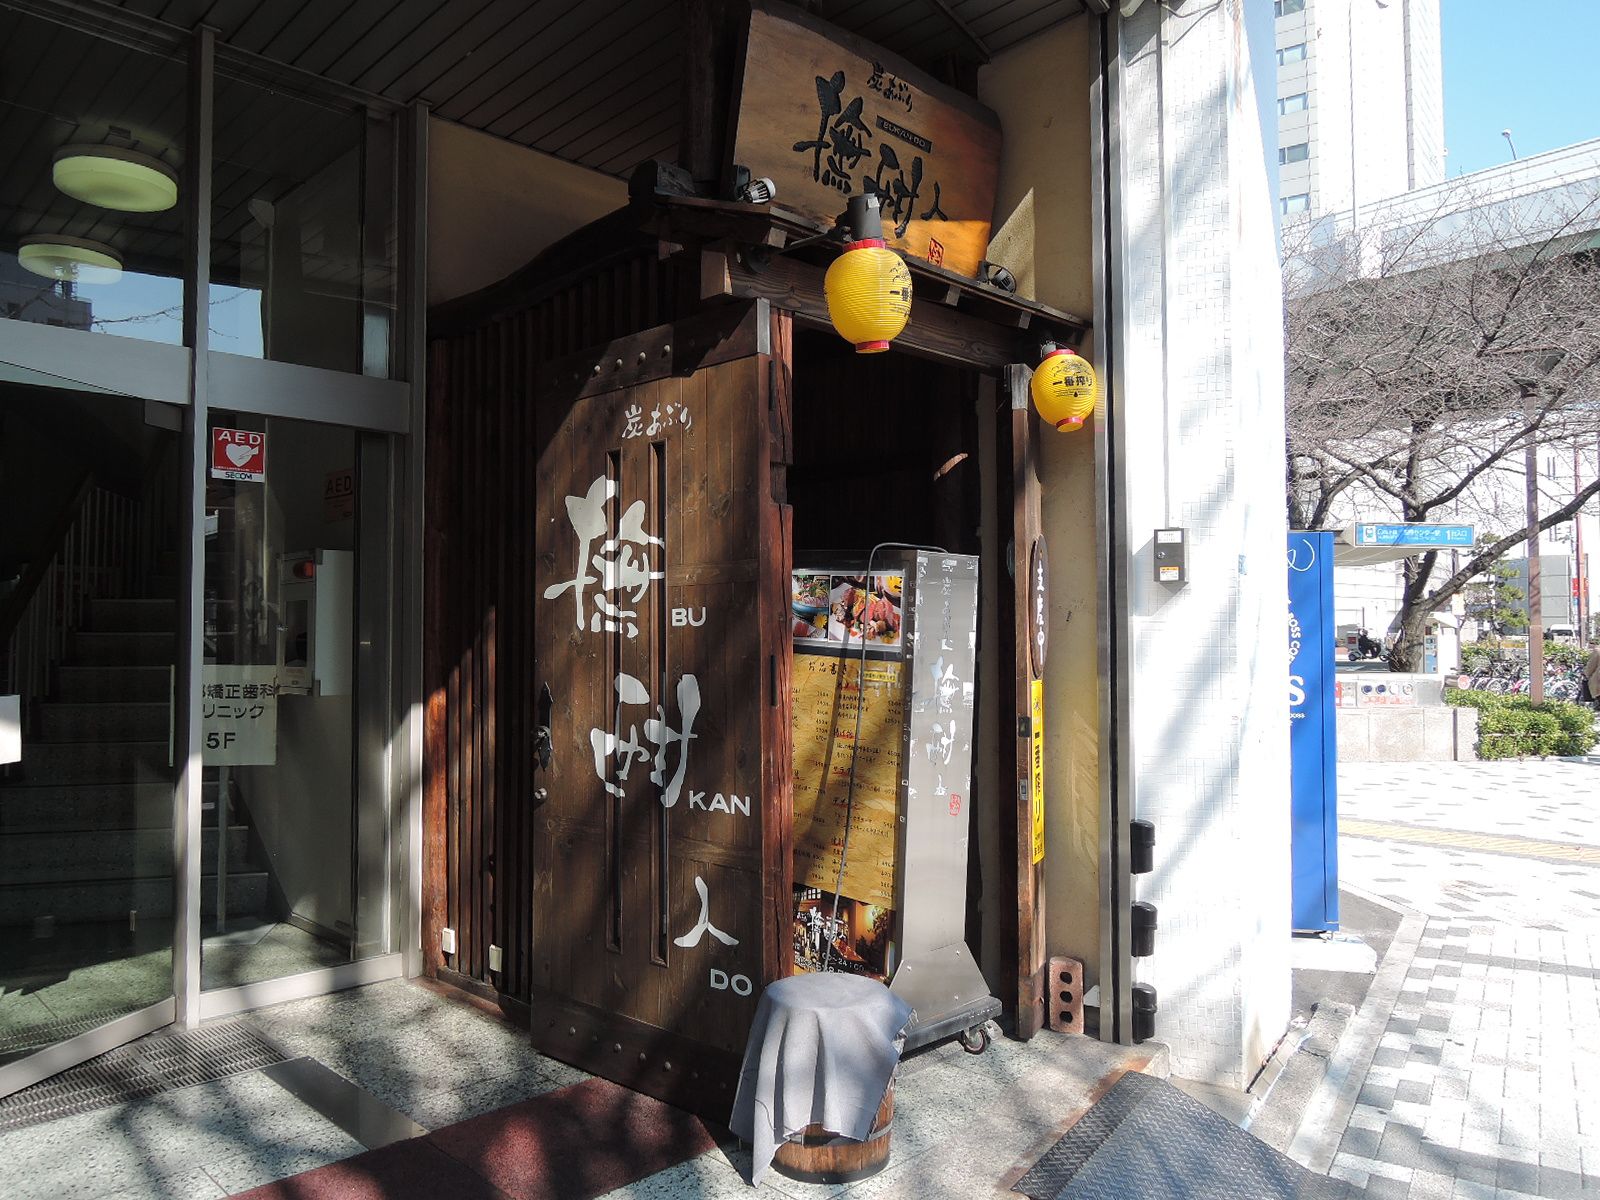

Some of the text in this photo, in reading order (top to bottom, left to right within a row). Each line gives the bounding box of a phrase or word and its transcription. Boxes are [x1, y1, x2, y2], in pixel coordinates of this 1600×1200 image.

[218, 430, 261, 445] AED
[225, 471, 253, 480] SECOM
[671, 606, 707, 628] BU
[206, 732, 236, 749] 5F
[688, 789, 752, 817] KAN
[709, 967, 753, 997] DO
